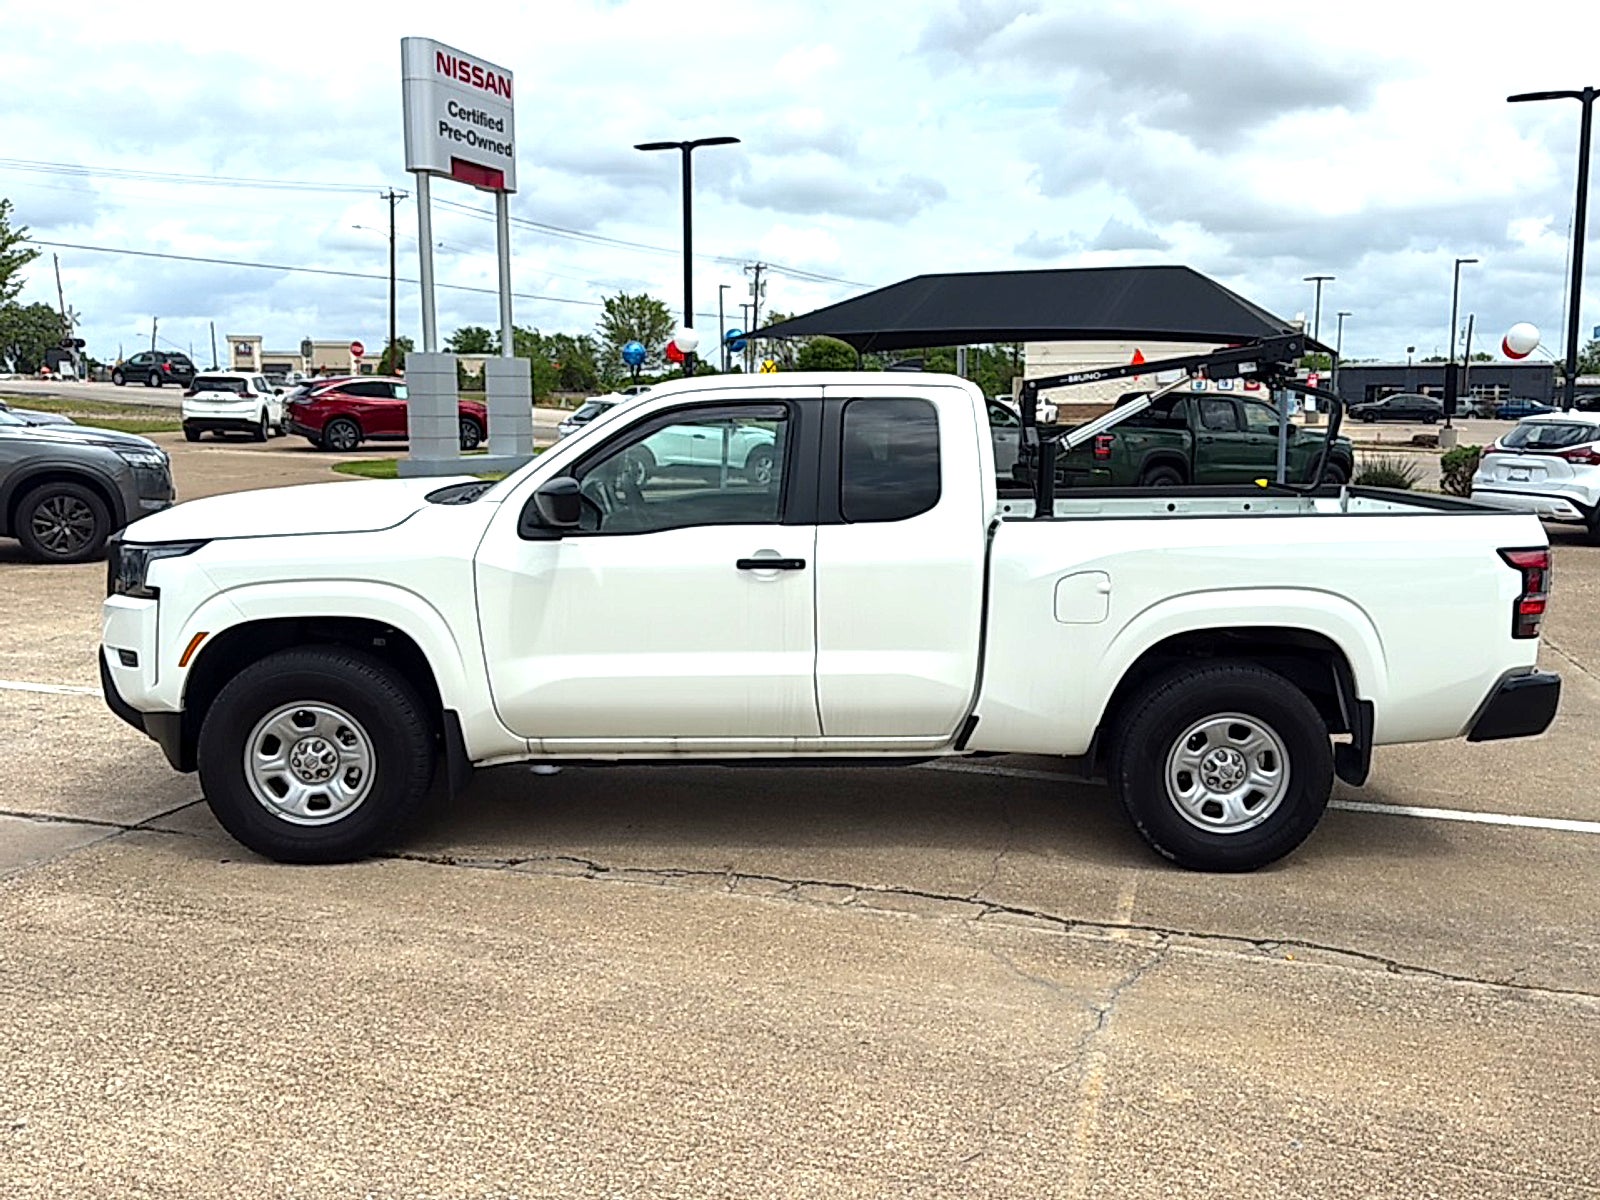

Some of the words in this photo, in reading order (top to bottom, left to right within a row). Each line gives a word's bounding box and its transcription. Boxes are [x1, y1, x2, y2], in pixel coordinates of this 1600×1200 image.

[436, 51, 512, 99] NISSAN
[447, 100, 504, 132] Certified
[439, 120, 512, 157] Pre-Owned
